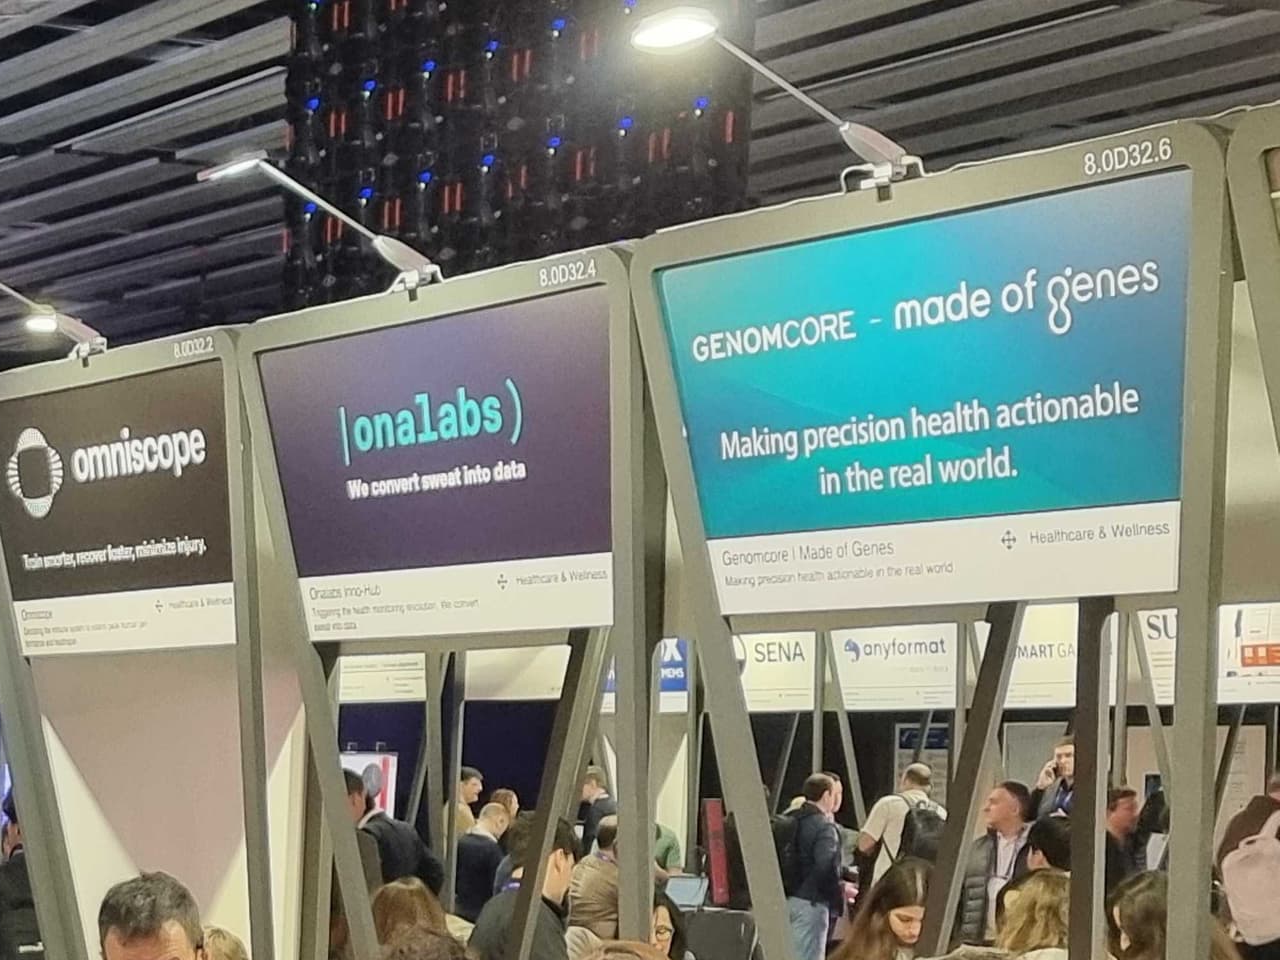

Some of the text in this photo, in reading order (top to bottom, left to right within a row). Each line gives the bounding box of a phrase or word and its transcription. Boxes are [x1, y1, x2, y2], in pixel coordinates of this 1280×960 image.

[1084, 137, 1172, 176] 8.0D32.6
[539, 259, 596, 287] 8.0D32.4
[692, 310, 856, 362] GENOMCORE
[894, 281, 991, 330] made
[1001, 268, 1038, 310] of
[1047, 261, 1158, 334] genes
[721, 381, 1139, 463] Making precision health actionable
[72, 427, 207, 482] omniscope
[819, 446, 1018, 495] in the real world.
[347, 460, 527, 499] We convert sweat into data
[76, 549, 107, 565] recover
[135, 538, 176, 558] minimize
[176, 536, 208, 556] injury.
[1029, 522, 1171, 545] Healthcare & Wellness
[722, 549, 789, 566] Genomcore
[799, 545, 833, 561] Made
[836, 542, 848, 557] of
[851, 540, 895, 557] Genes
[754, 640, 805, 664] SENA
[862, 637, 947, 659] anyformat
